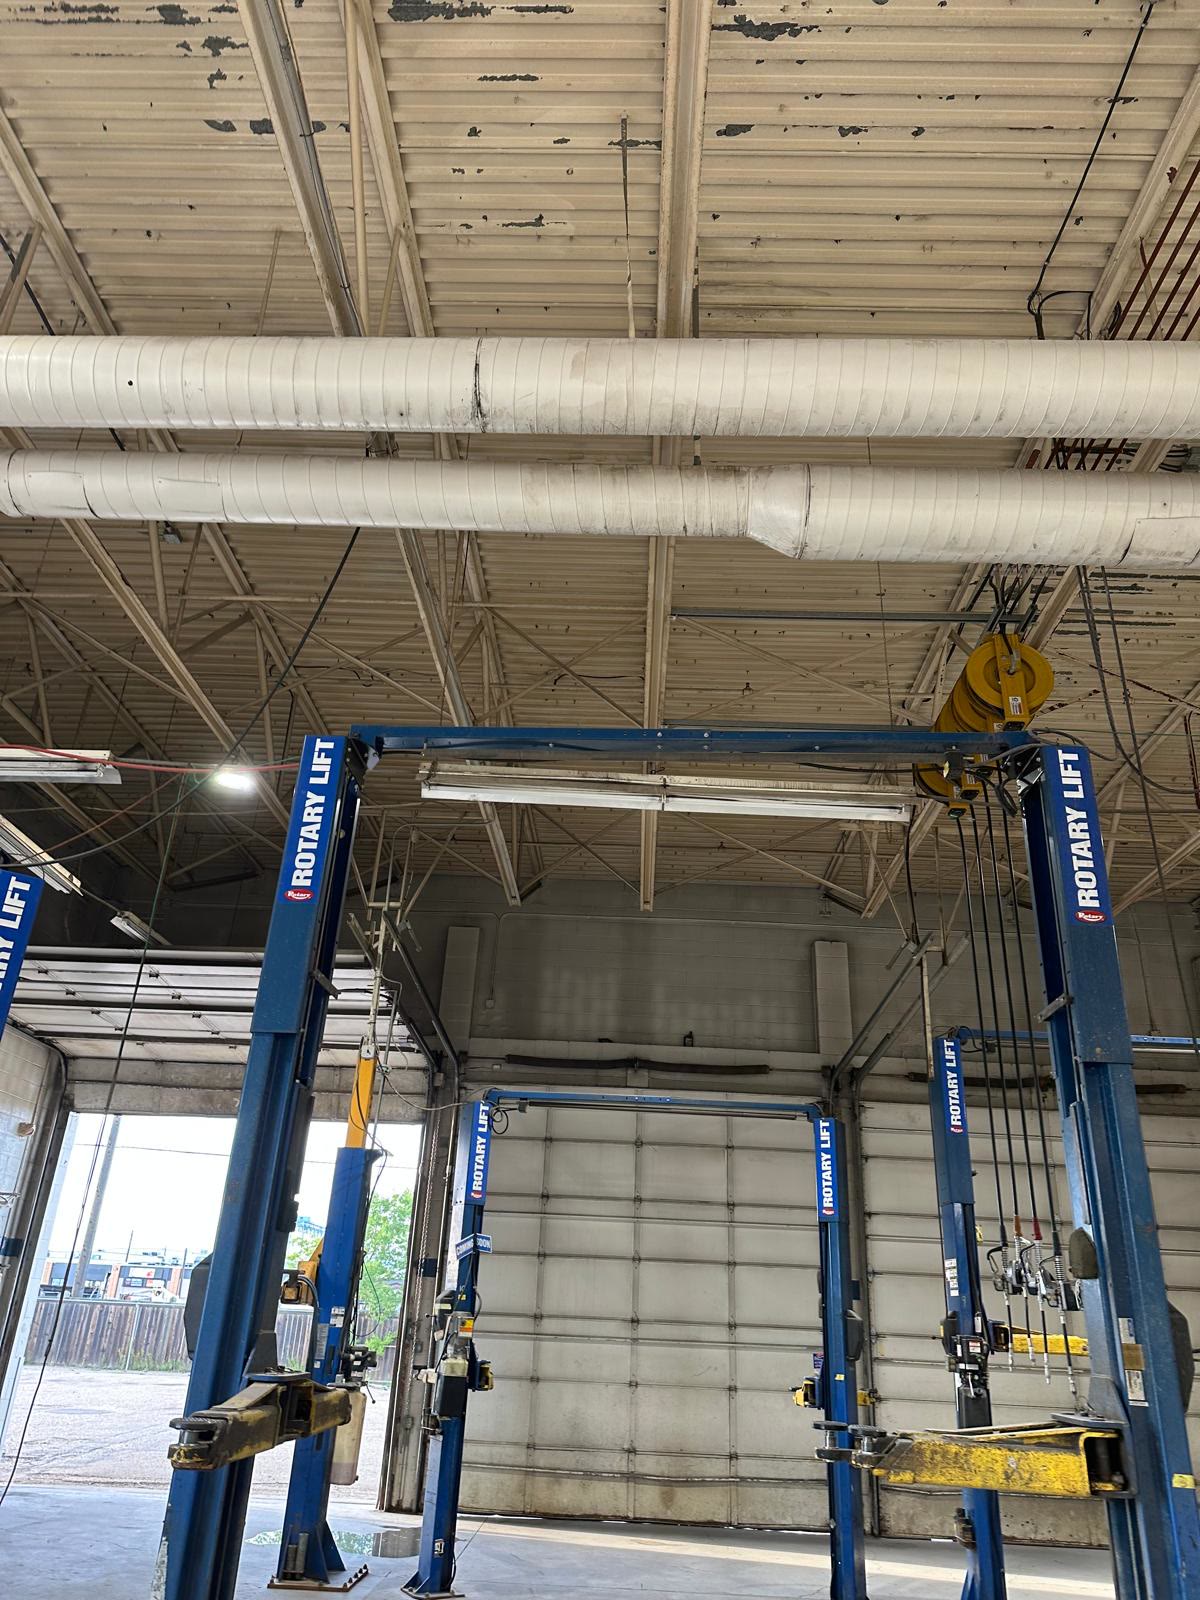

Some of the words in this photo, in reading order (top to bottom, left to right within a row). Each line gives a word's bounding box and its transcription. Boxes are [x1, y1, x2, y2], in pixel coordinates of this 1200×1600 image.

[1058, 750, 1084, 799] LIFT
[291, 791, 325, 886] ROTARY
[309, 738, 335, 785] LIFT
[1065, 806, 1100, 908] ROTARY
[0, 876, 30, 929] LIFT
[944, 1039, 957, 1067] LIFT
[479, 1103, 490, 1133] LIFT
[947, 1070, 962, 1126] ROTARY
[819, 1119, 831, 1149] LIFT
[472, 1136, 487, 1191] ROTARY
[821, 1152, 833, 1208] ROTARY
